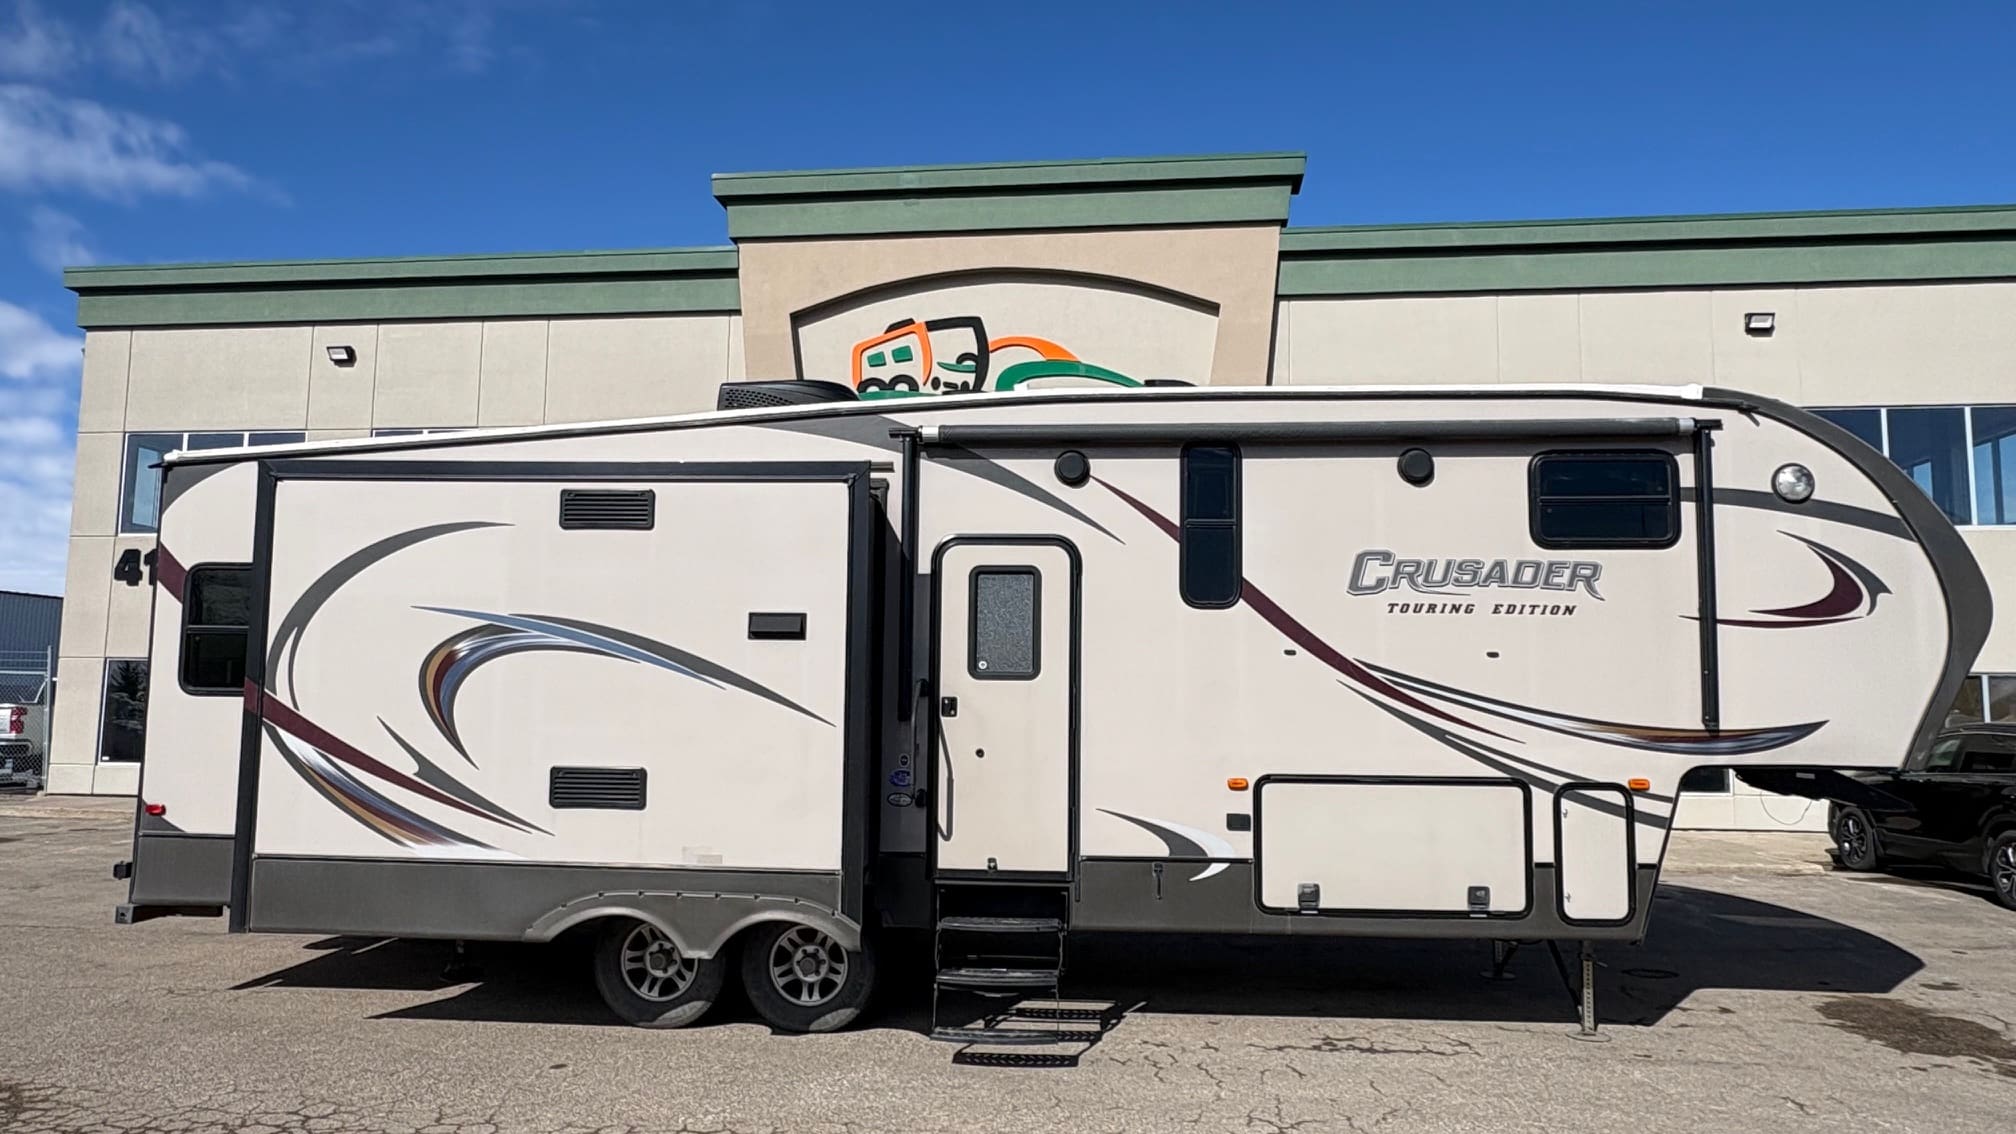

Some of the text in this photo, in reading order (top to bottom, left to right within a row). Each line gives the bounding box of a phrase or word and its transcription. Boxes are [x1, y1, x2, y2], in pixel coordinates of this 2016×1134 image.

[1346, 549, 1605, 601] CRUSADER
[1387, 602, 1577, 616] TOURING EDITION
